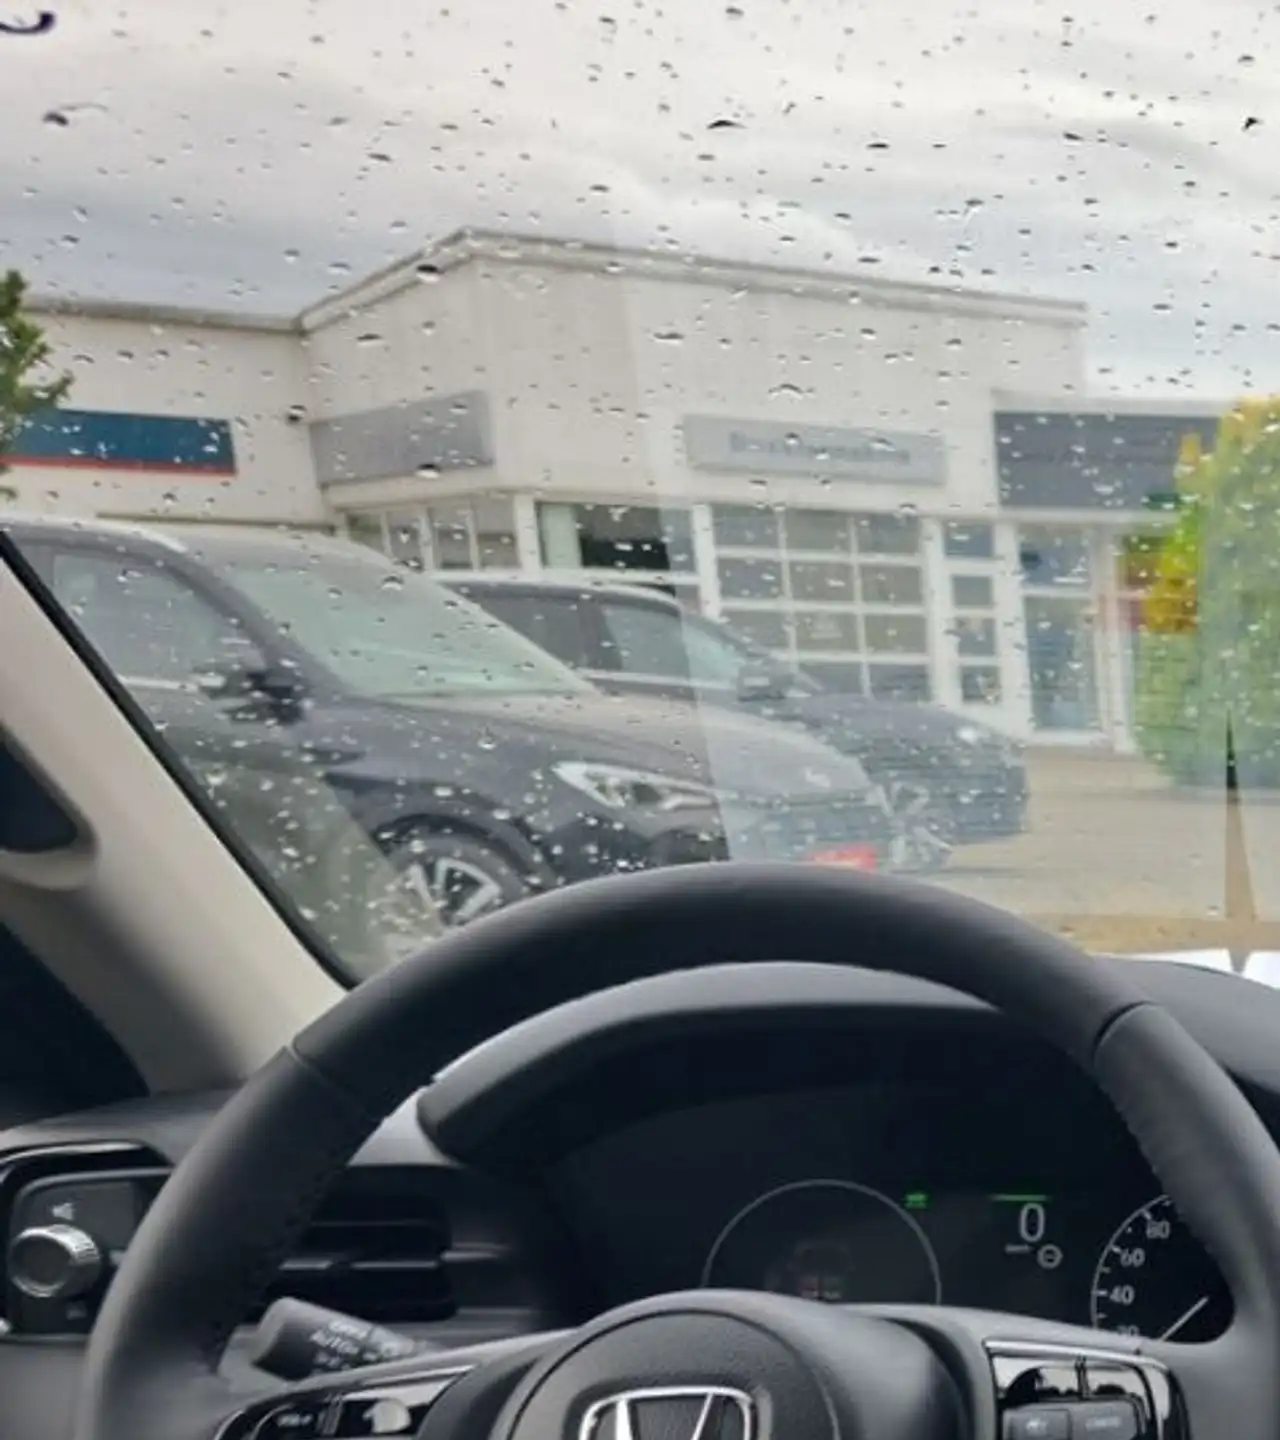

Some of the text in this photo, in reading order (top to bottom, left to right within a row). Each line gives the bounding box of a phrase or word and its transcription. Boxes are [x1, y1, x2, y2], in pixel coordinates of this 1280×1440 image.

[1146, 1220, 1171, 1239] 80
[1120, 1248, 1146, 1267] 60
[1109, 1285, 1135, 1305] 40
